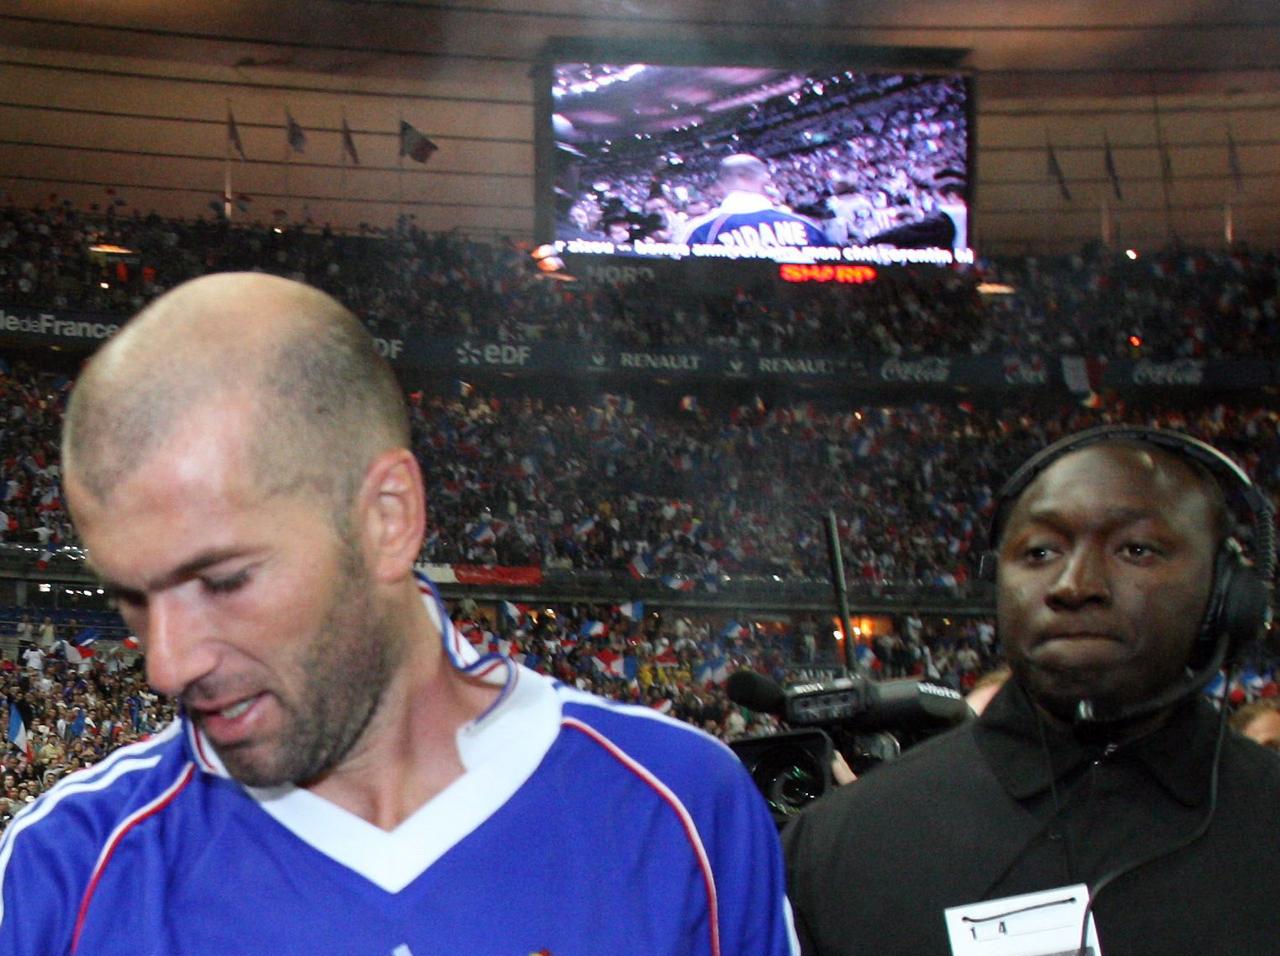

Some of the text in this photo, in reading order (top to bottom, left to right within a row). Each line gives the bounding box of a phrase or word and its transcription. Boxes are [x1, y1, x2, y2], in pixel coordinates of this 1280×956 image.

[780, 264, 877, 284] SHARP
[373, 338, 404, 360] DF
[620, 352, 701, 371] RENAULT
[759, 356, 834, 374] RENAULT
[998, 921, 1007, 936] 4
